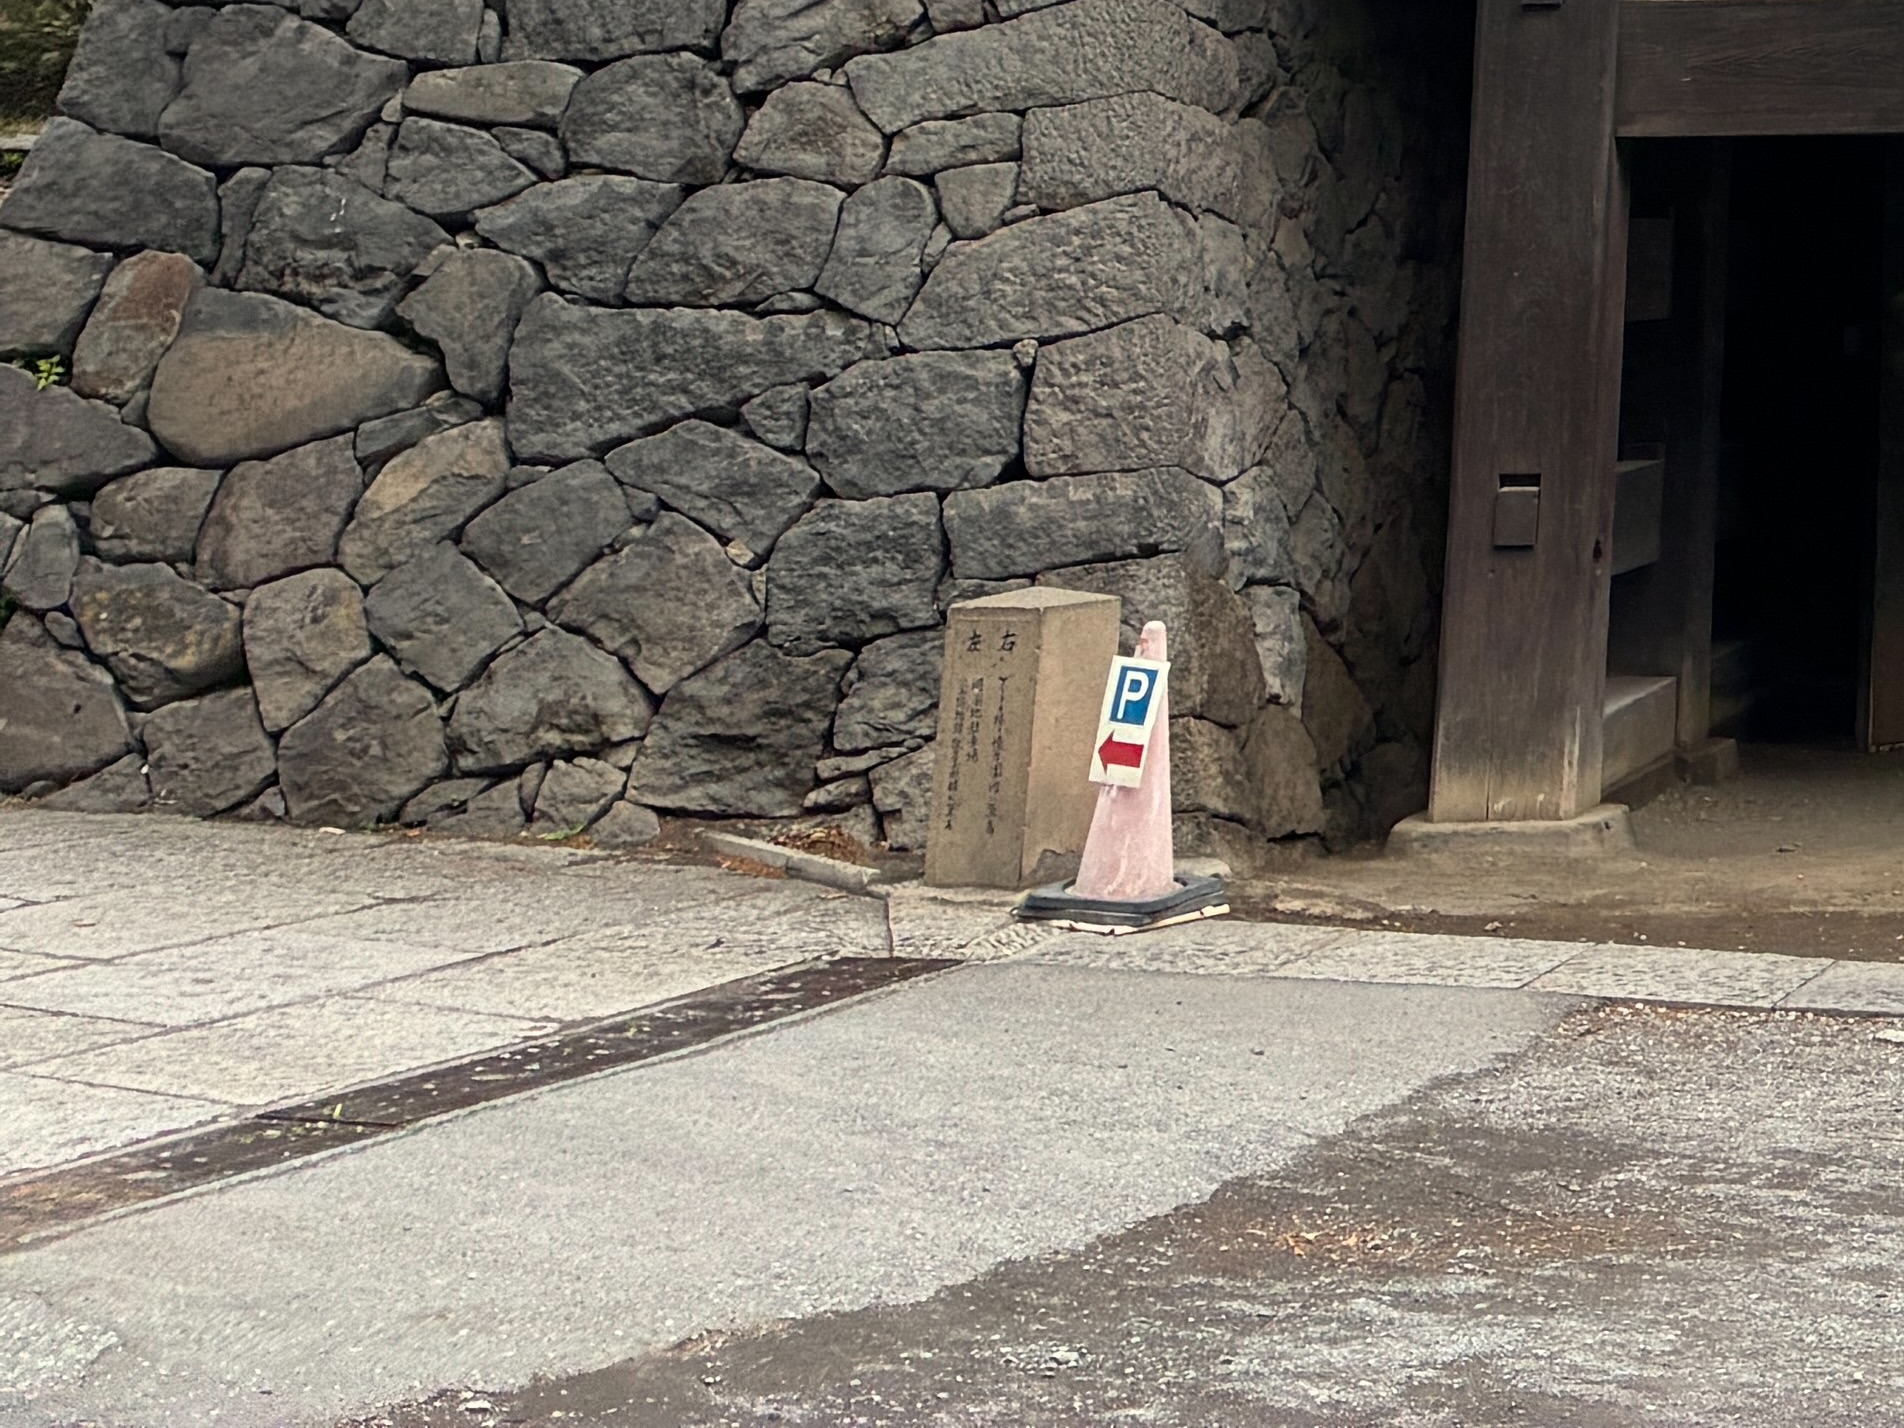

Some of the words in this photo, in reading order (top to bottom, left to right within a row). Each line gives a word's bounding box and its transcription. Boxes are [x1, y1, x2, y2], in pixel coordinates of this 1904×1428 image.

[966, 630, 983, 652] 左
[998, 630, 1018, 652] 右
[1116, 670, 1149, 720] P
